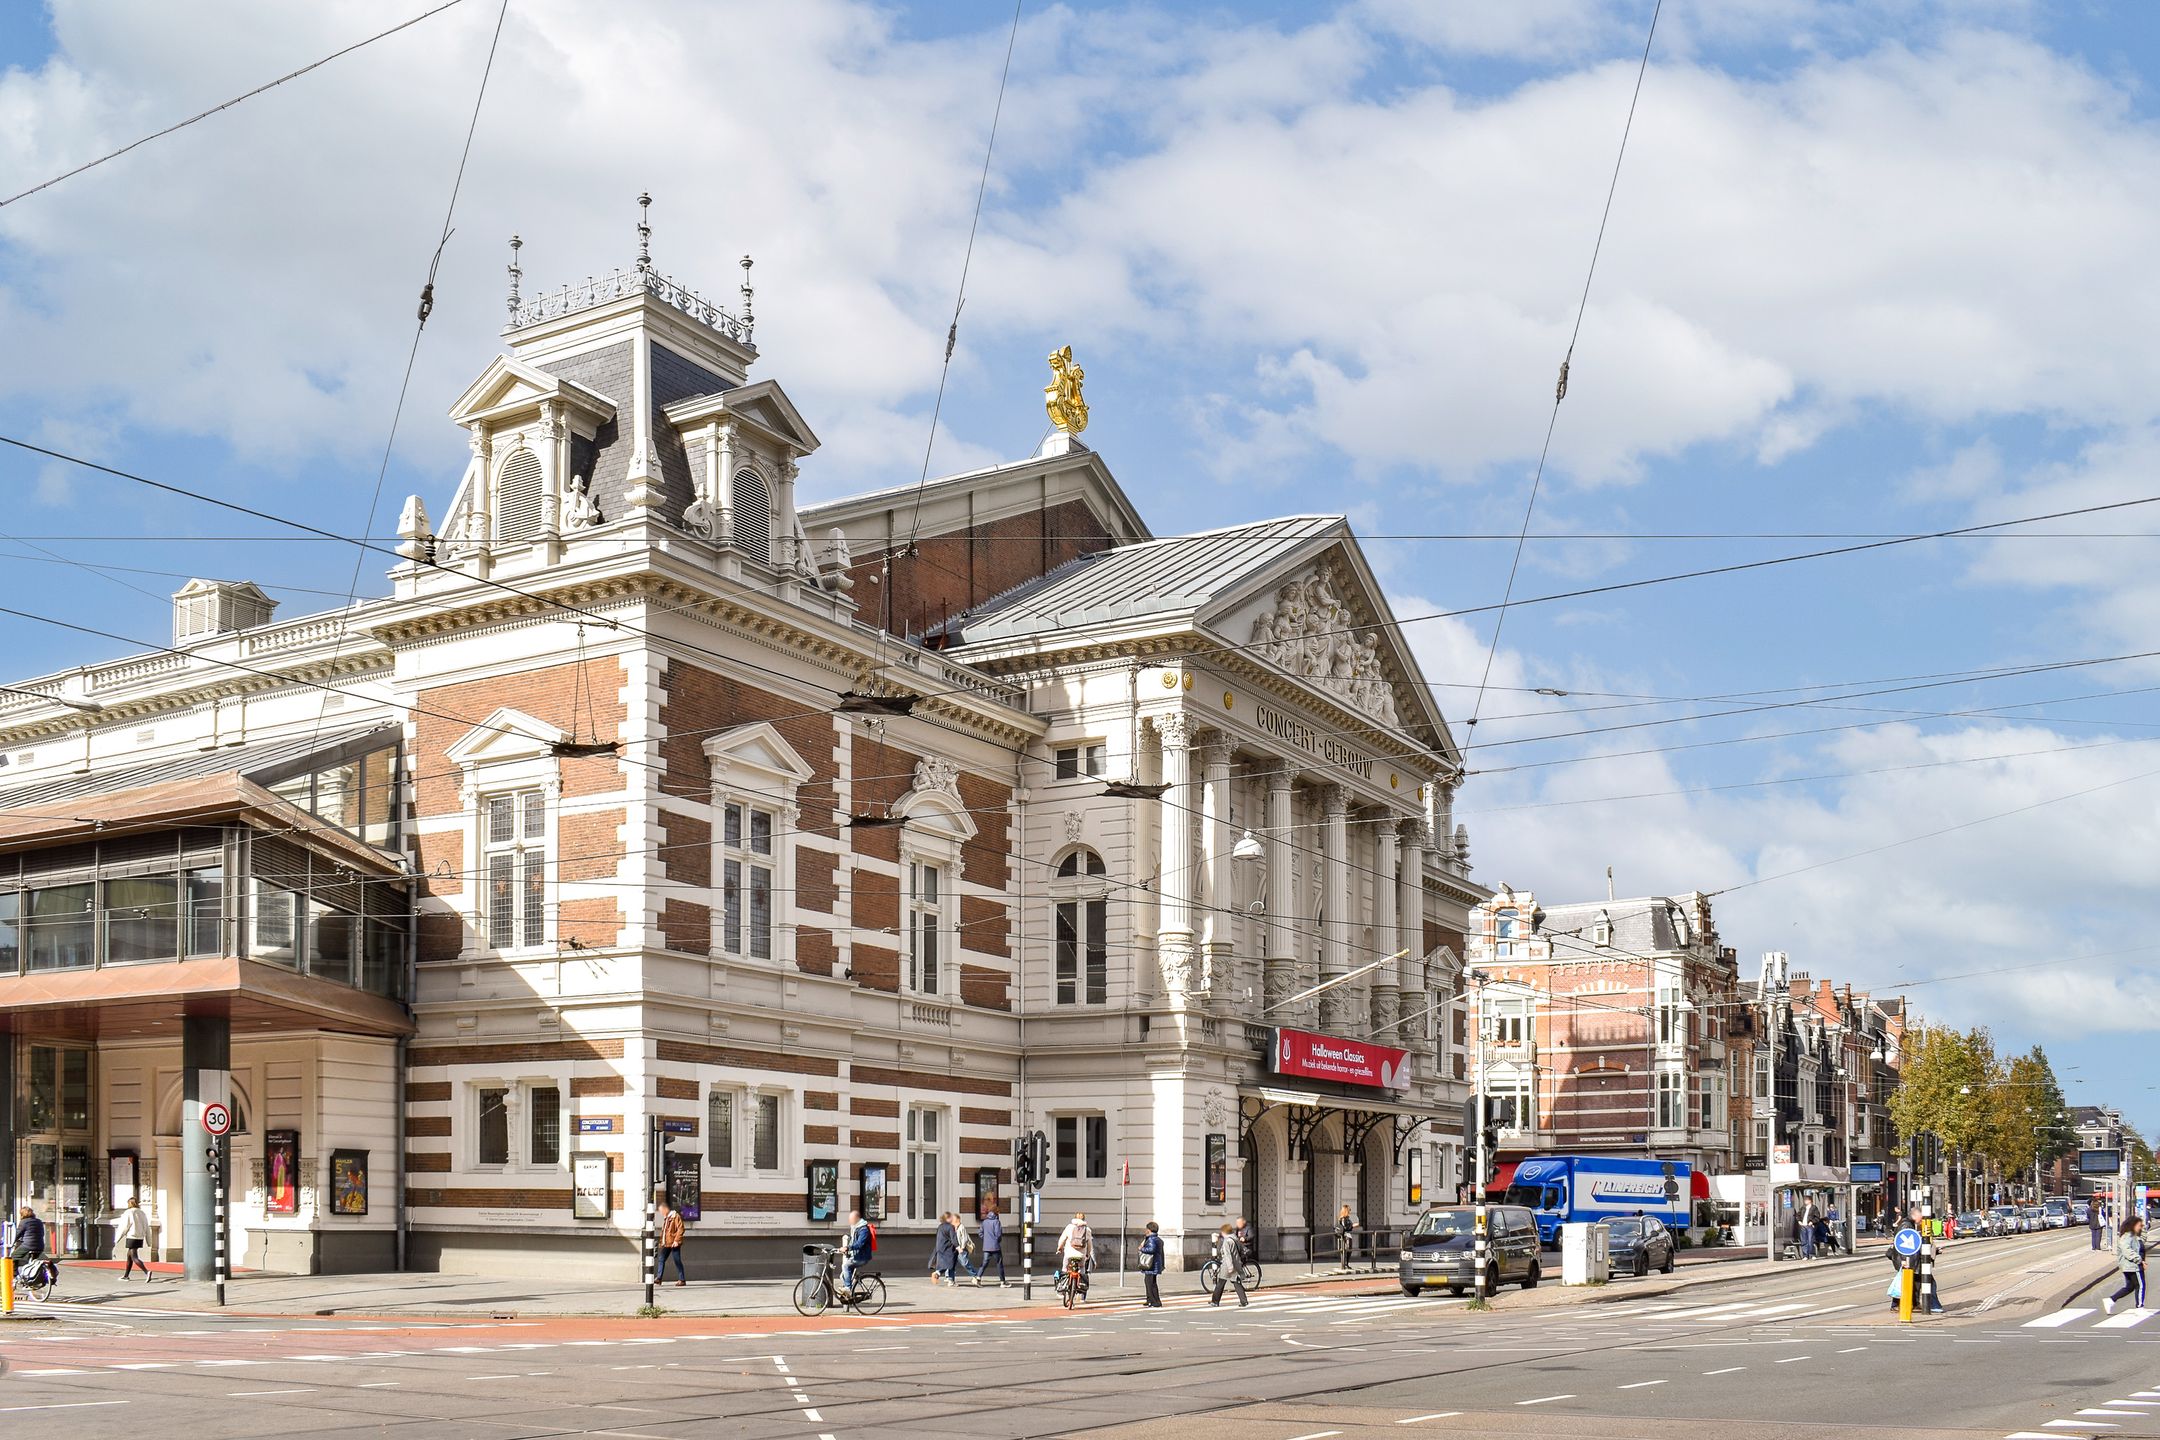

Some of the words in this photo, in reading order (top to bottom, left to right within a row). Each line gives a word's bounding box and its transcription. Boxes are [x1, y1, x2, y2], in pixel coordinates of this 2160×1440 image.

[1311, 1043, 1343, 1061] Halloween
[1343, 1049, 1365, 1064] Classics
[1302, 1058, 1316, 1069] Muziek
[1321, 1061, 1337, 1072] bekende
[208, 1112, 226, 1126] 30
[336, 1164, 342, 1174] 5
